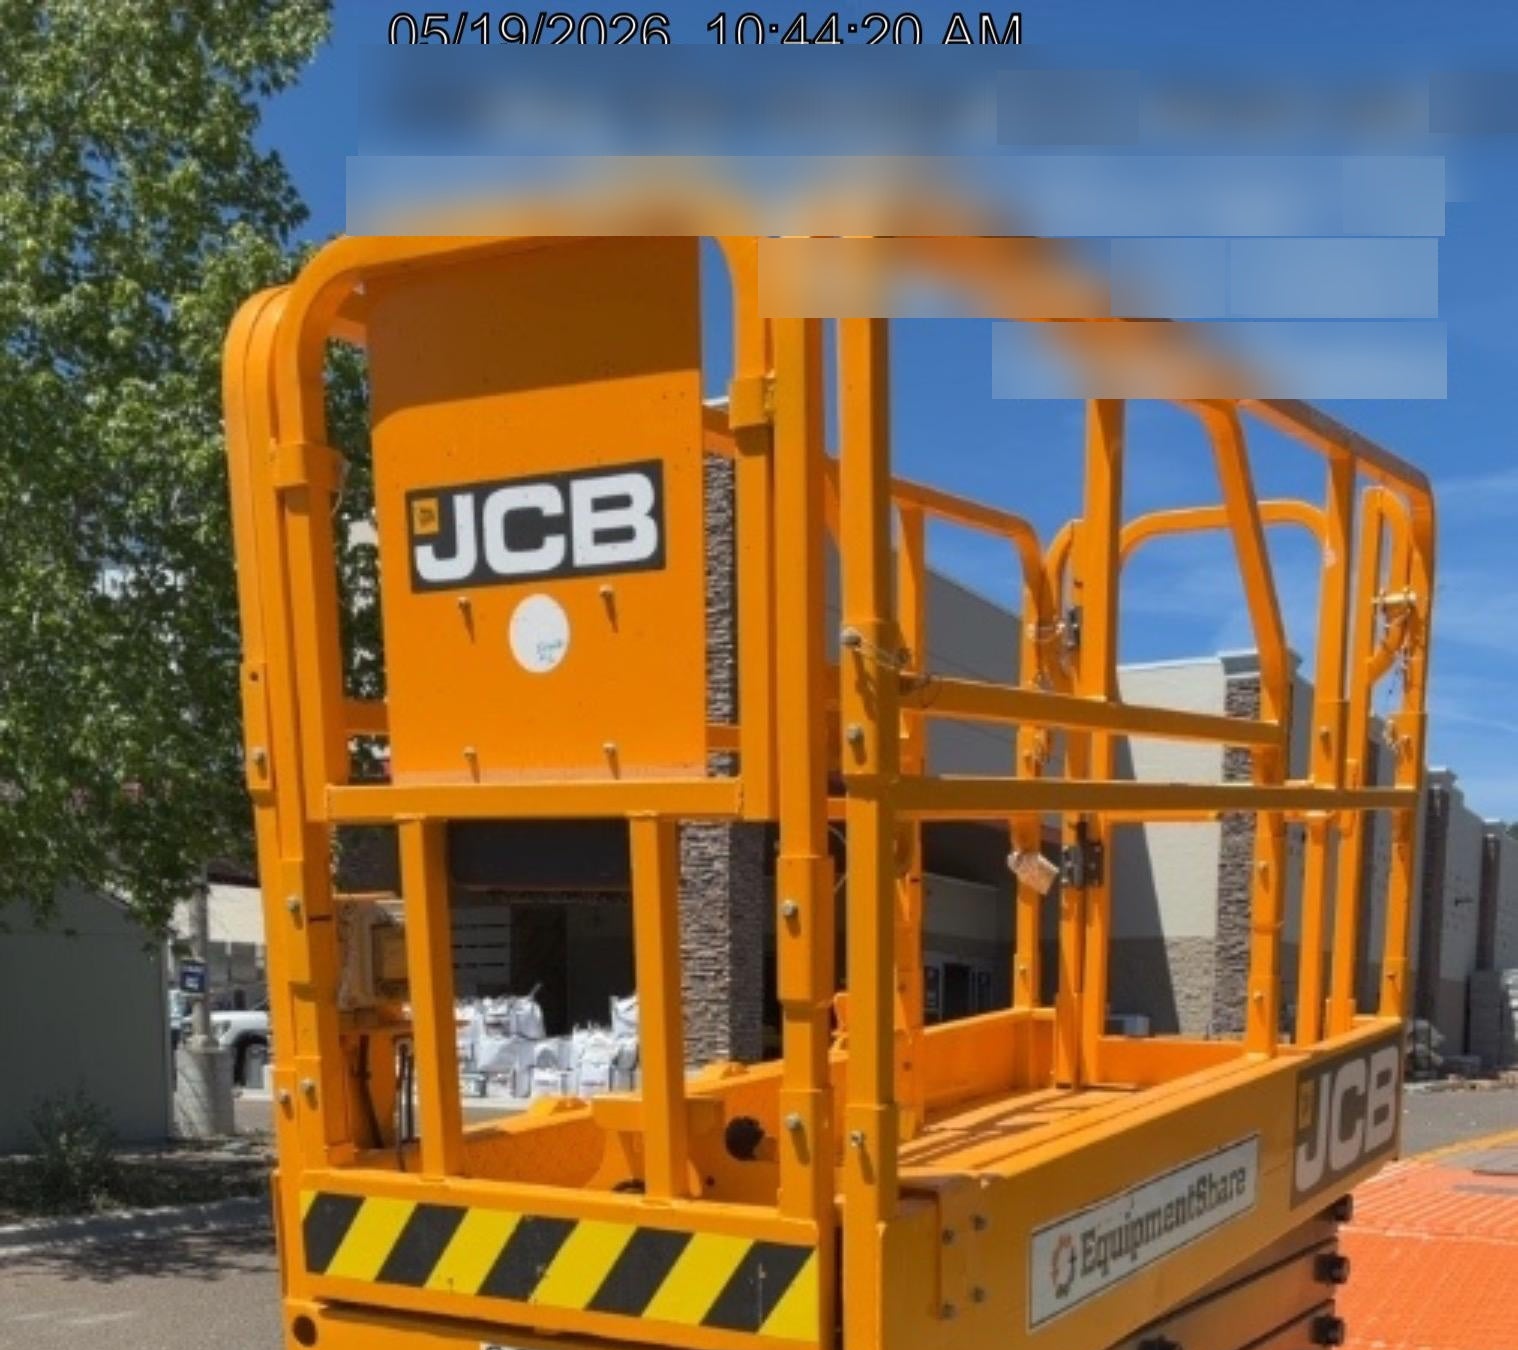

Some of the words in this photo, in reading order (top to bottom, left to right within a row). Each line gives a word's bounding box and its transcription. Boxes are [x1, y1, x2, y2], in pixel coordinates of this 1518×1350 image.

[414, 472, 659, 583] JCB
[1294, 1045, 1399, 1193] JCB
[1080, 1165, 1247, 1278] EquipmentShare
